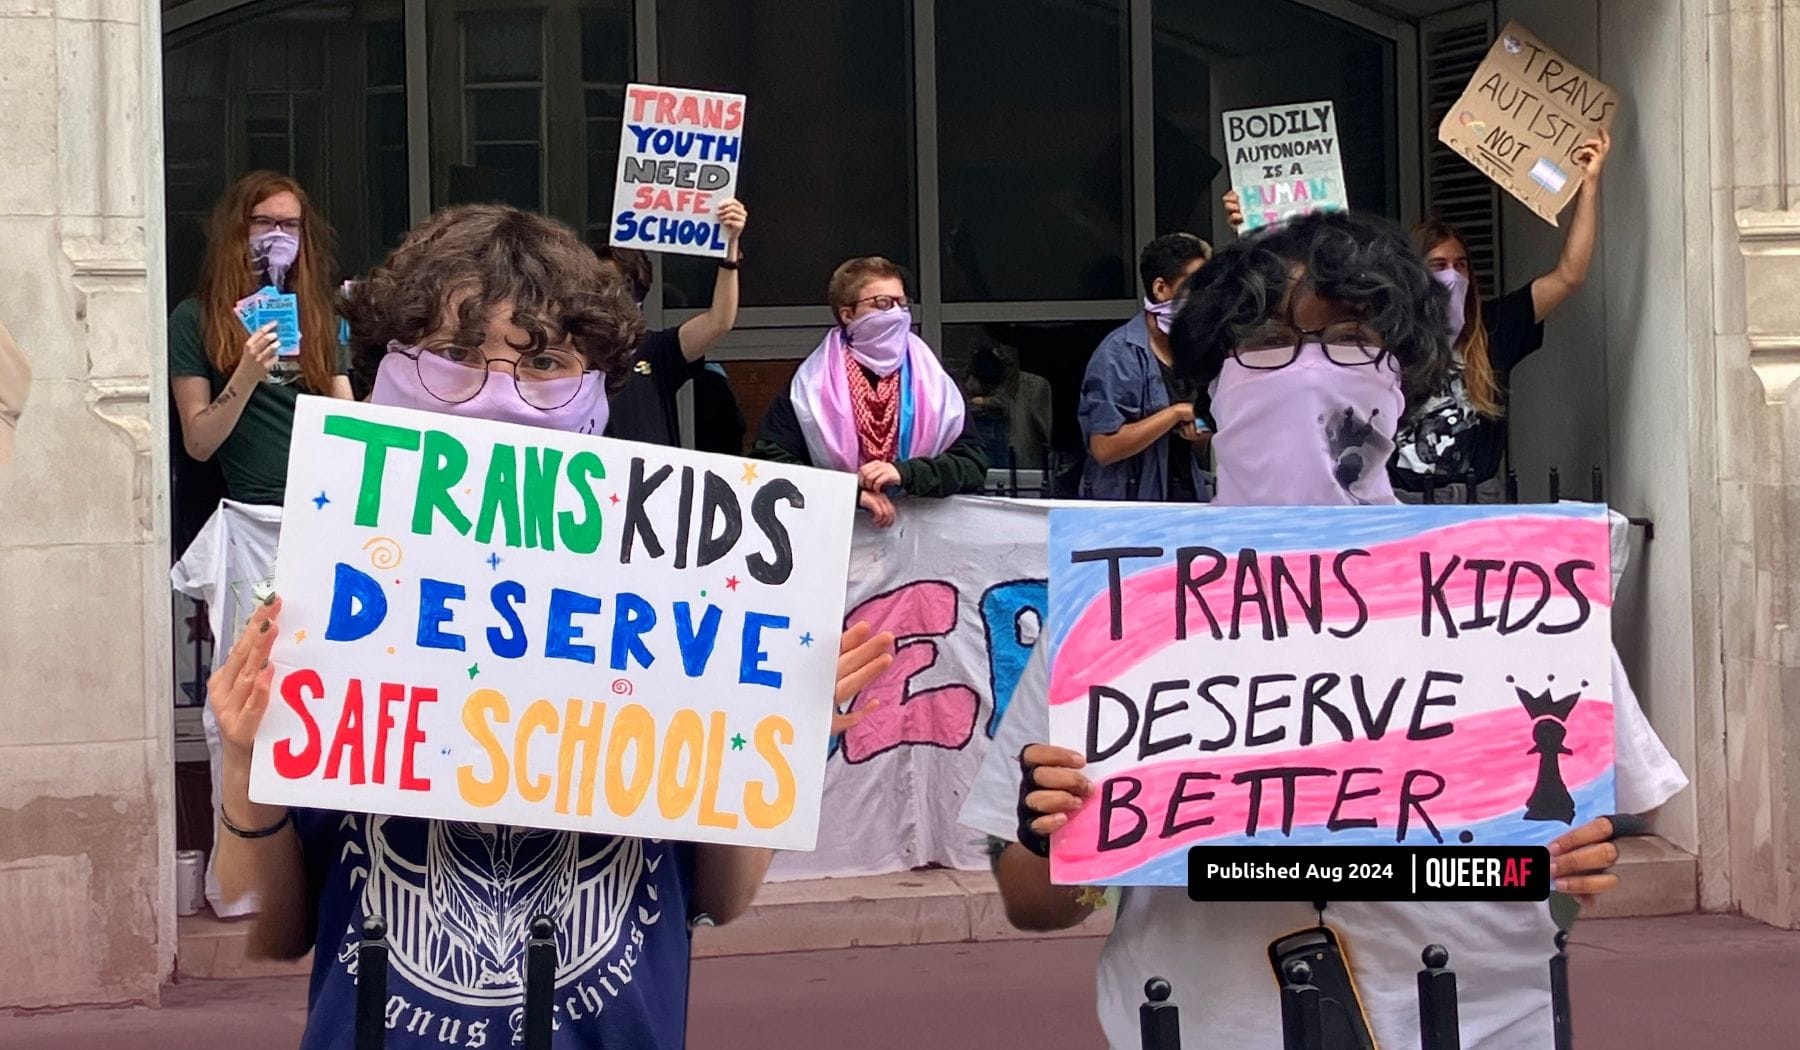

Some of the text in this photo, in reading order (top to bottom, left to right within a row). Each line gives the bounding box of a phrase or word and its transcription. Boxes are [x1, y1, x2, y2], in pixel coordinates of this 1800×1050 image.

[1524, 42, 1615, 122] TRANS
[629, 90, 742, 130] TRANS
[1228, 105, 1331, 142] BODILY
[627, 125, 739, 162] YOUTH
[1235, 138, 1334, 164] AUTONOMY
[1484, 126, 1531, 163] NOT
[624, 156, 730, 191] NEED
[1262, 162, 1304, 179] IS A
[633, 186, 712, 214] SAFE
[1242, 177, 1328, 207] HUMAN
[614, 211, 726, 250] SCHOOL
[323, 414, 805, 585] TRANS KIDS
[1071, 546, 1596, 641] TRANS KIDS
[324, 562, 791, 689] DESERVE
[1085, 670, 1463, 763] DESERVE
[272, 669, 796, 829] SAFE SCHOOLS
[1097, 767, 1474, 852] BETTER.
